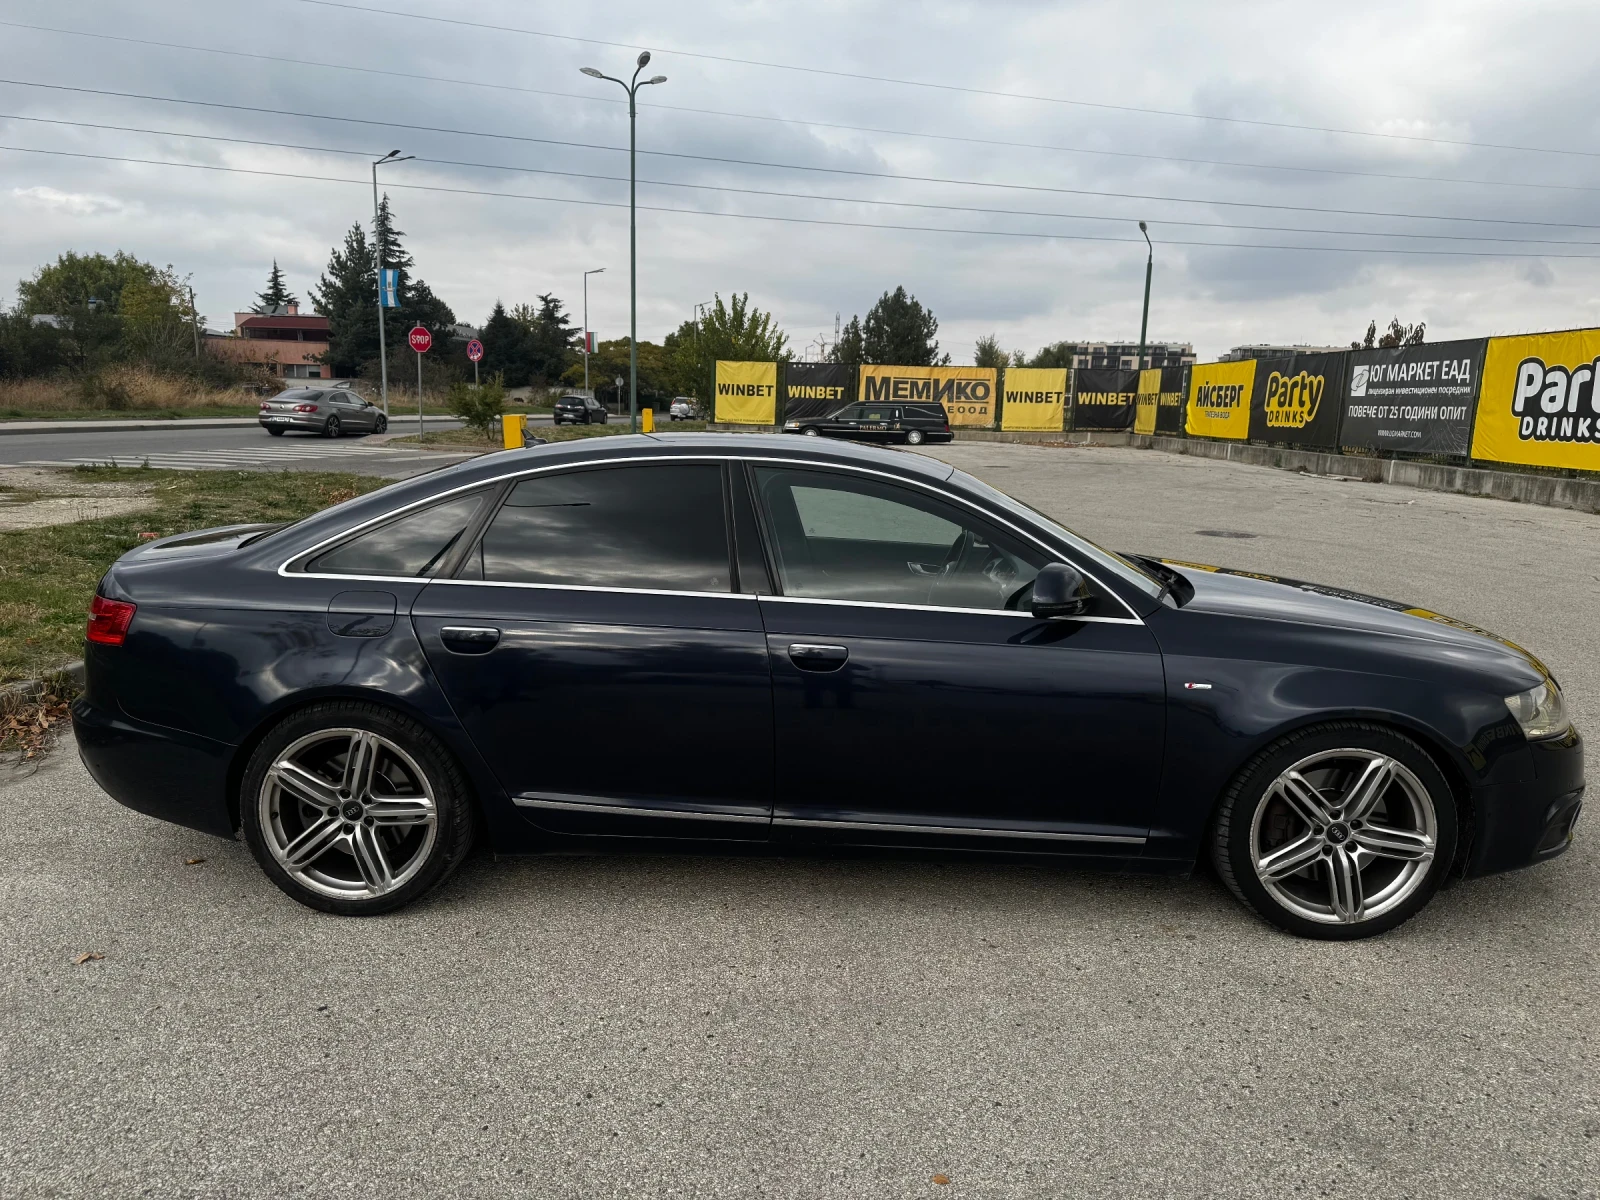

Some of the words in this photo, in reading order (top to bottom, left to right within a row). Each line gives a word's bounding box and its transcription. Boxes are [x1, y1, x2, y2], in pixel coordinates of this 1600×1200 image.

[411, 335, 429, 344] STOP
[1369, 364, 1387, 382] ЮГ
[1386, 361, 1440, 381] МАРКЕТ
[1441, 359, 1471, 383] ЕАД
[718, 383, 774, 397] WINBET
[787, 385, 845, 399] WINBET
[864, 376, 990, 403] МЕМИКО
[1196, 381, 1244, 408] АЙСБЕРГ
[1266, 375, 1322, 417] Party
[1367, 387, 1395, 397] лицензиран
[1395, 386, 1438, 396] инвестиционен
[1438, 386, 1472, 396] посредник
[1006, 391, 1063, 404] WINBET
[1078, 392, 1135, 406] WINBET
[1160, 392, 1181, 406] WINBET
[947, 405, 989, 415] ЕООД
[1268, 410, 1305, 424] DRINKS
[1348, 405, 1378, 418] ПОВЕЧЕ
[1378, 405, 1389, 419] ОТ
[1389, 406, 1399, 419] 25
[1399, 406, 1439, 421] ГОДИНИ
[1439, 406, 1467, 420] ОПИТ
